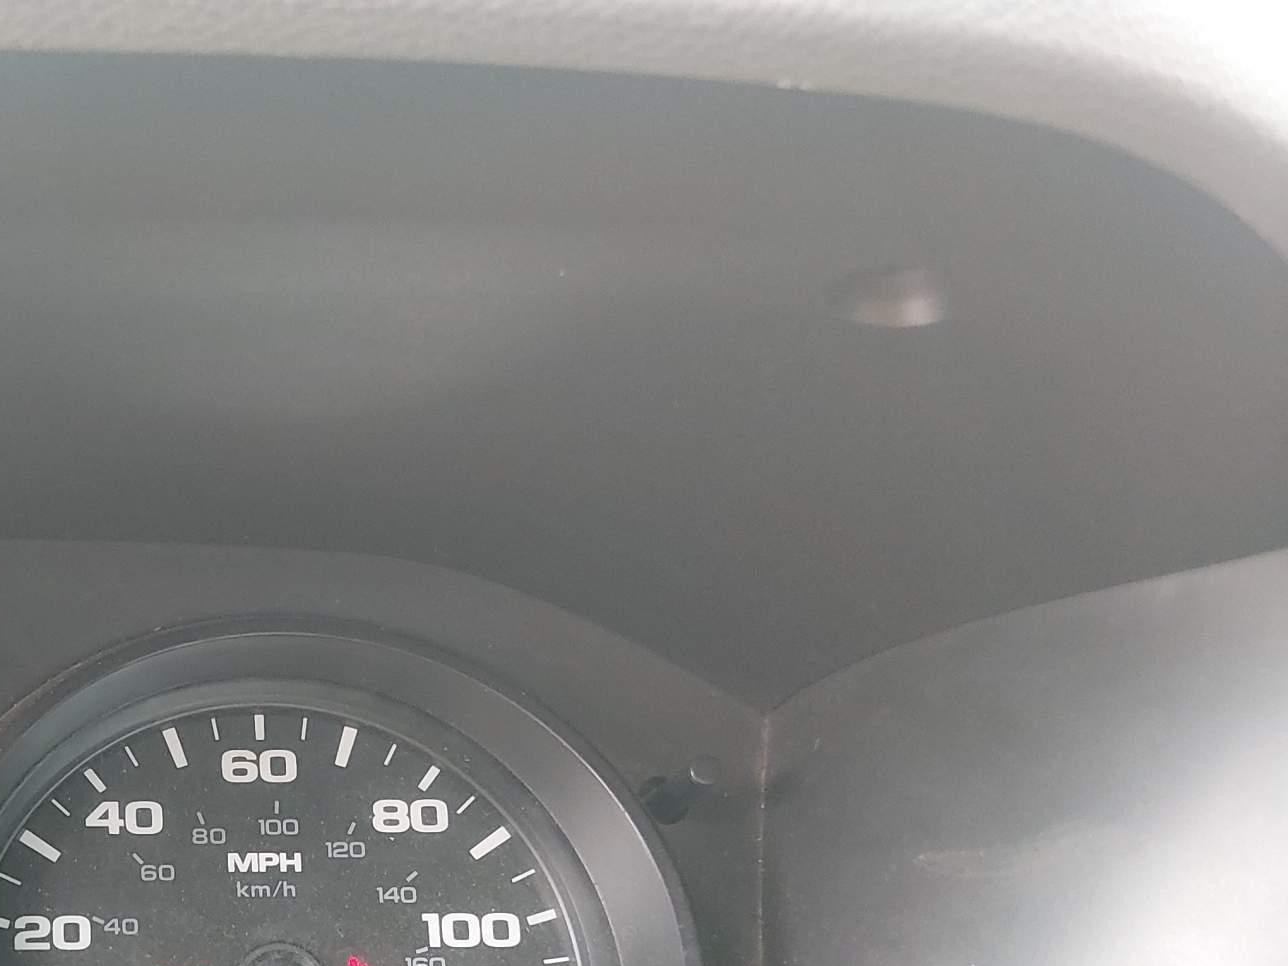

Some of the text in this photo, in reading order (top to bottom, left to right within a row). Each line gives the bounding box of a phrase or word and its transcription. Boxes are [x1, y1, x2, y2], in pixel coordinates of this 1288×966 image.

[221, 749, 298, 783] 60
[85, 801, 164, 835] 40
[371, 799, 449, 833] 80
[257, 819, 299, 836] 100
[192, 828, 227, 845] 80
[325, 841, 366, 858] 120
[227, 852, 302, 873] MPH
[141, 864, 176, 881] 60
[236, 881, 297, 898] km/h
[376, 886, 418, 903] 140
[14, 915, 91, 951] 20
[103, 918, 139, 935] 40
[421, 912, 521, 948] 100
